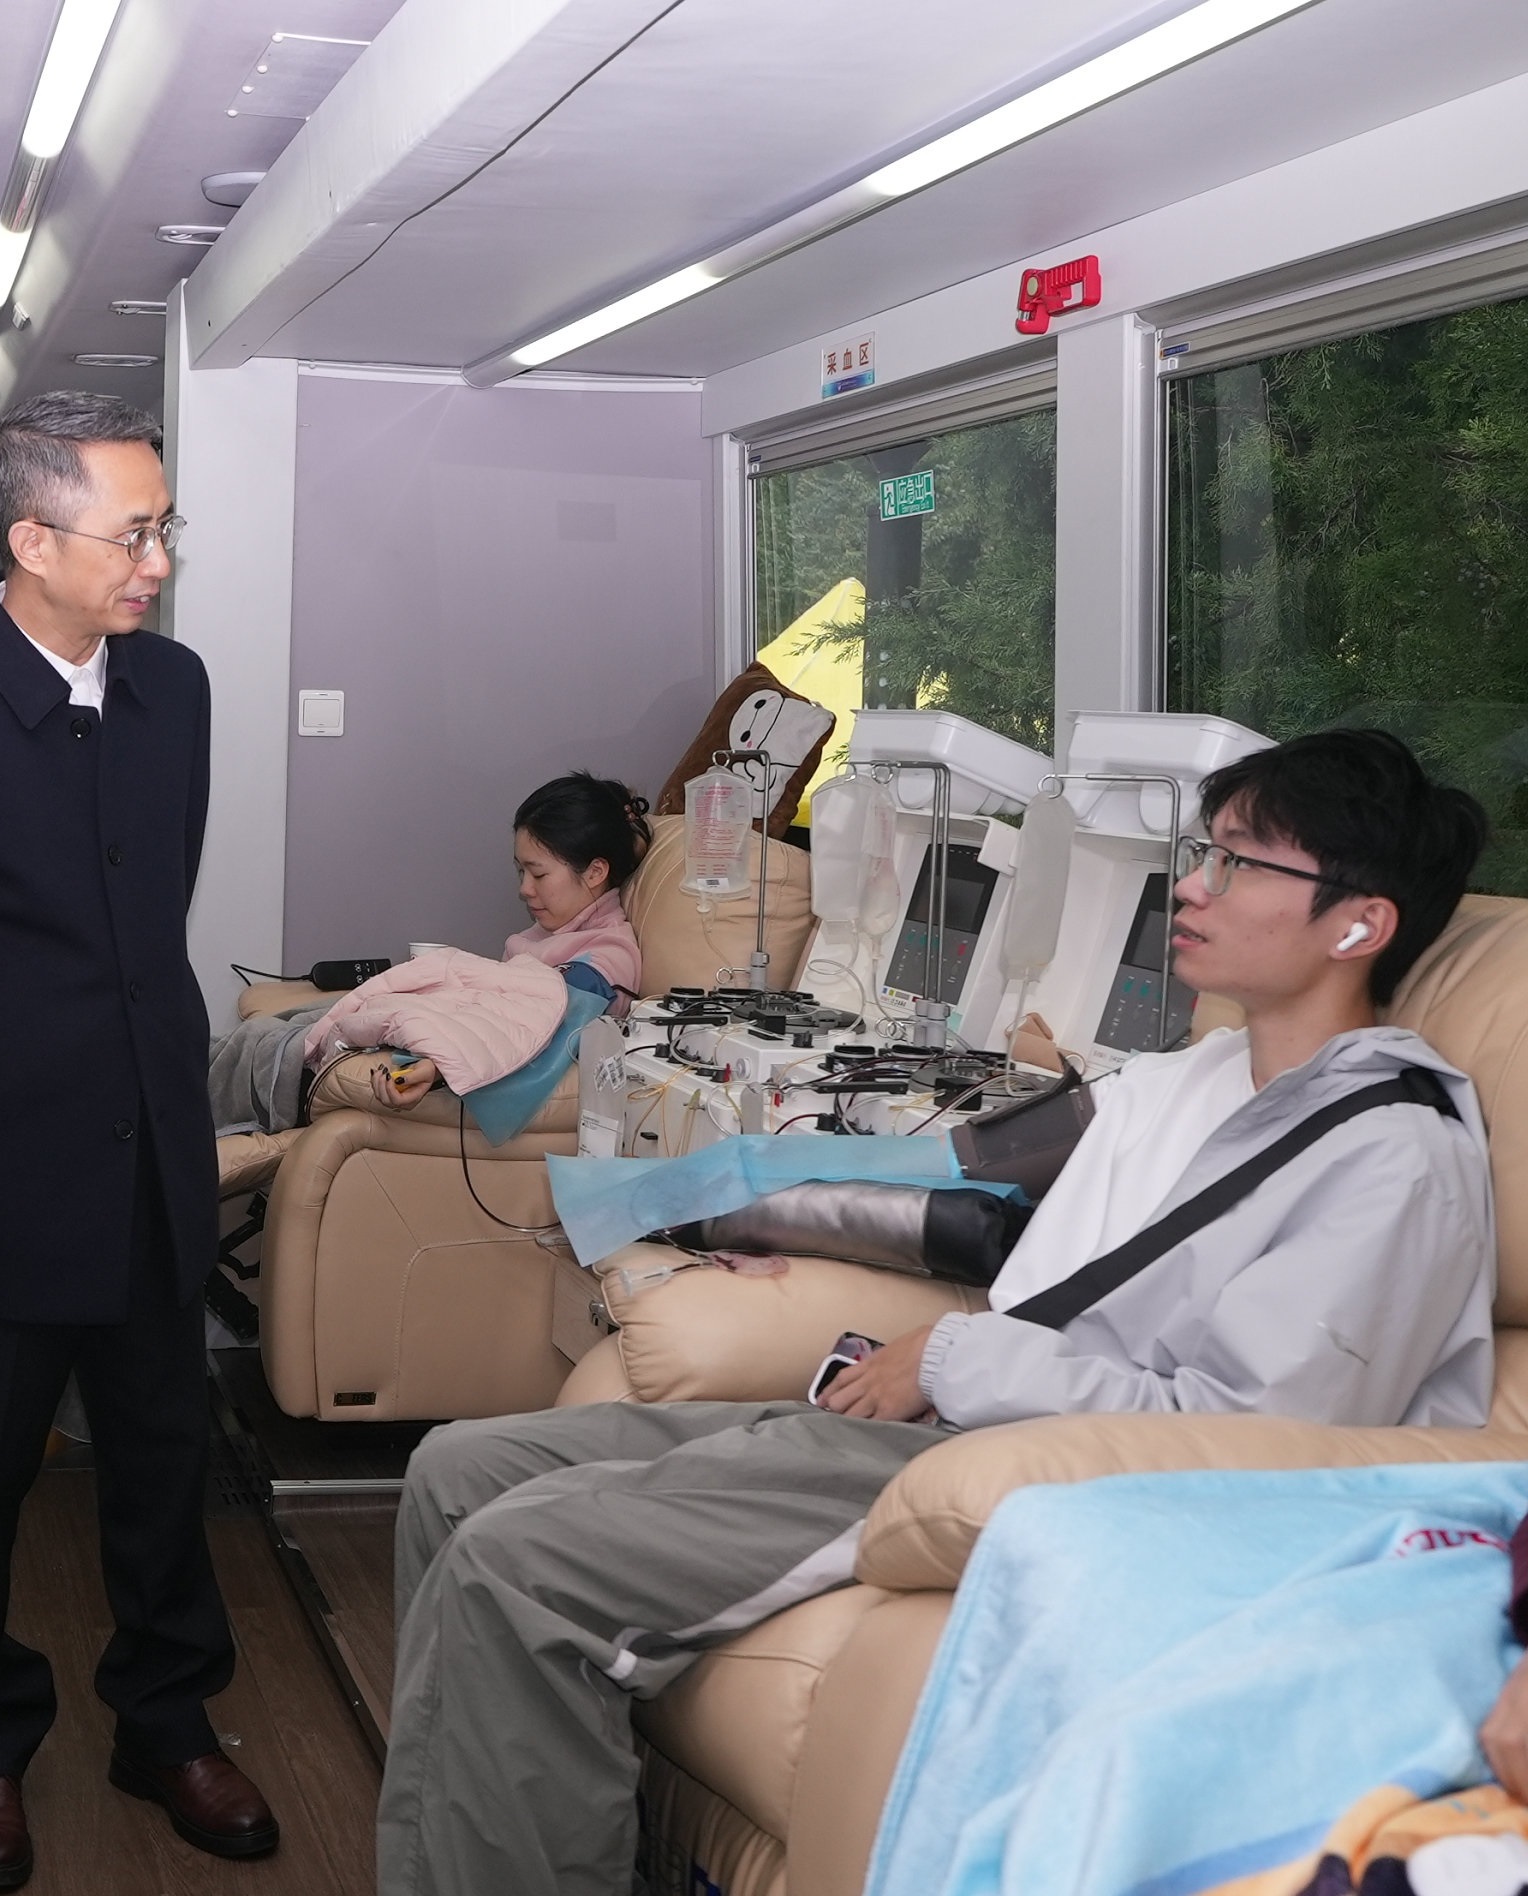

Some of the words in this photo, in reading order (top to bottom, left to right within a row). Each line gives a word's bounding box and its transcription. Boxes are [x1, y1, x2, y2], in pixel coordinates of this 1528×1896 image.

[826, 342, 870, 376] 采血区
[898, 474, 933, 504] 应急出口
